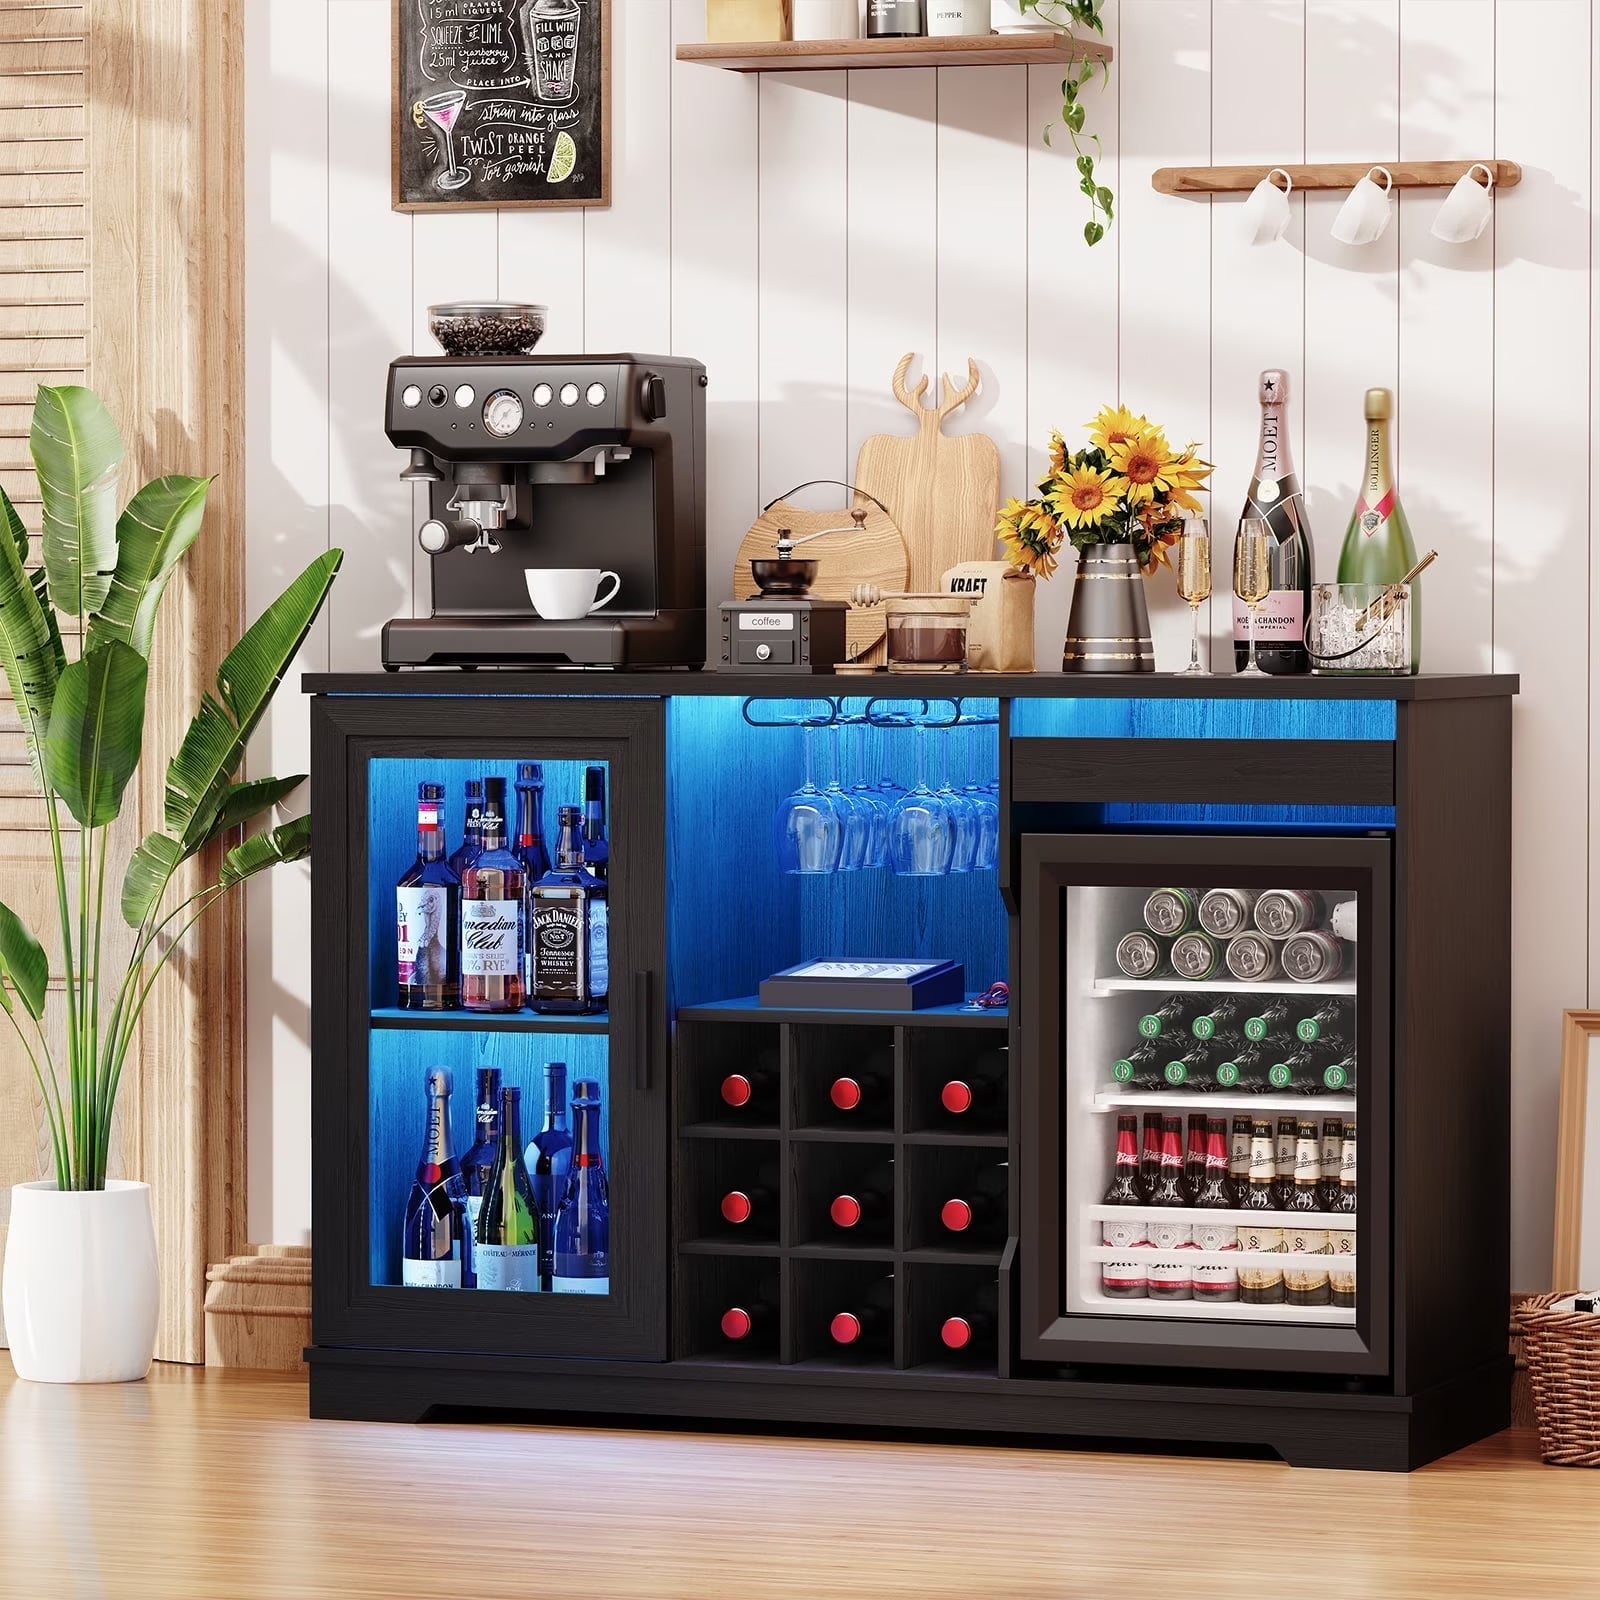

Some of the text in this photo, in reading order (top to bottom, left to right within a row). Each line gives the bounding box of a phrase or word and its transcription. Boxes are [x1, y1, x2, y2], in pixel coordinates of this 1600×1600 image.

[430, 3, 458, 19] 15 ml
[463, 7, 504, 15] LIQUEUR
[431, 25, 463, 46] SQUEEZE
[481, 22, 503, 44] LIME
[536, 21, 575, 34] FILL WITH
[459, 48, 510, 63] cranberry
[460, 57, 499, 73] juice
[540, 60, 571, 81] SHAKE
[467, 75, 521, 87] PLACE INTO
[478, 102, 580, 132] strain into glass
[461, 131, 545, 156] TWIST ORANGE
[509, 145, 546, 154] PEEL
[481, 155, 547, 182] for garnish
[1371, 429, 1380, 491] BOLLINGER
[950, 578, 987, 594] KRAFT
[751, 616, 781, 627] coffee
[1258, 616, 1295, 624] CHANDON
[533, 912, 553, 930] JACK
[540, 947, 575, 957] Tennessee
[1117, 1152, 1138, 1164] Bud
[1162, 1154, 1183, 1166] Bud
[1207, 1155, 1228, 1167] Bud
